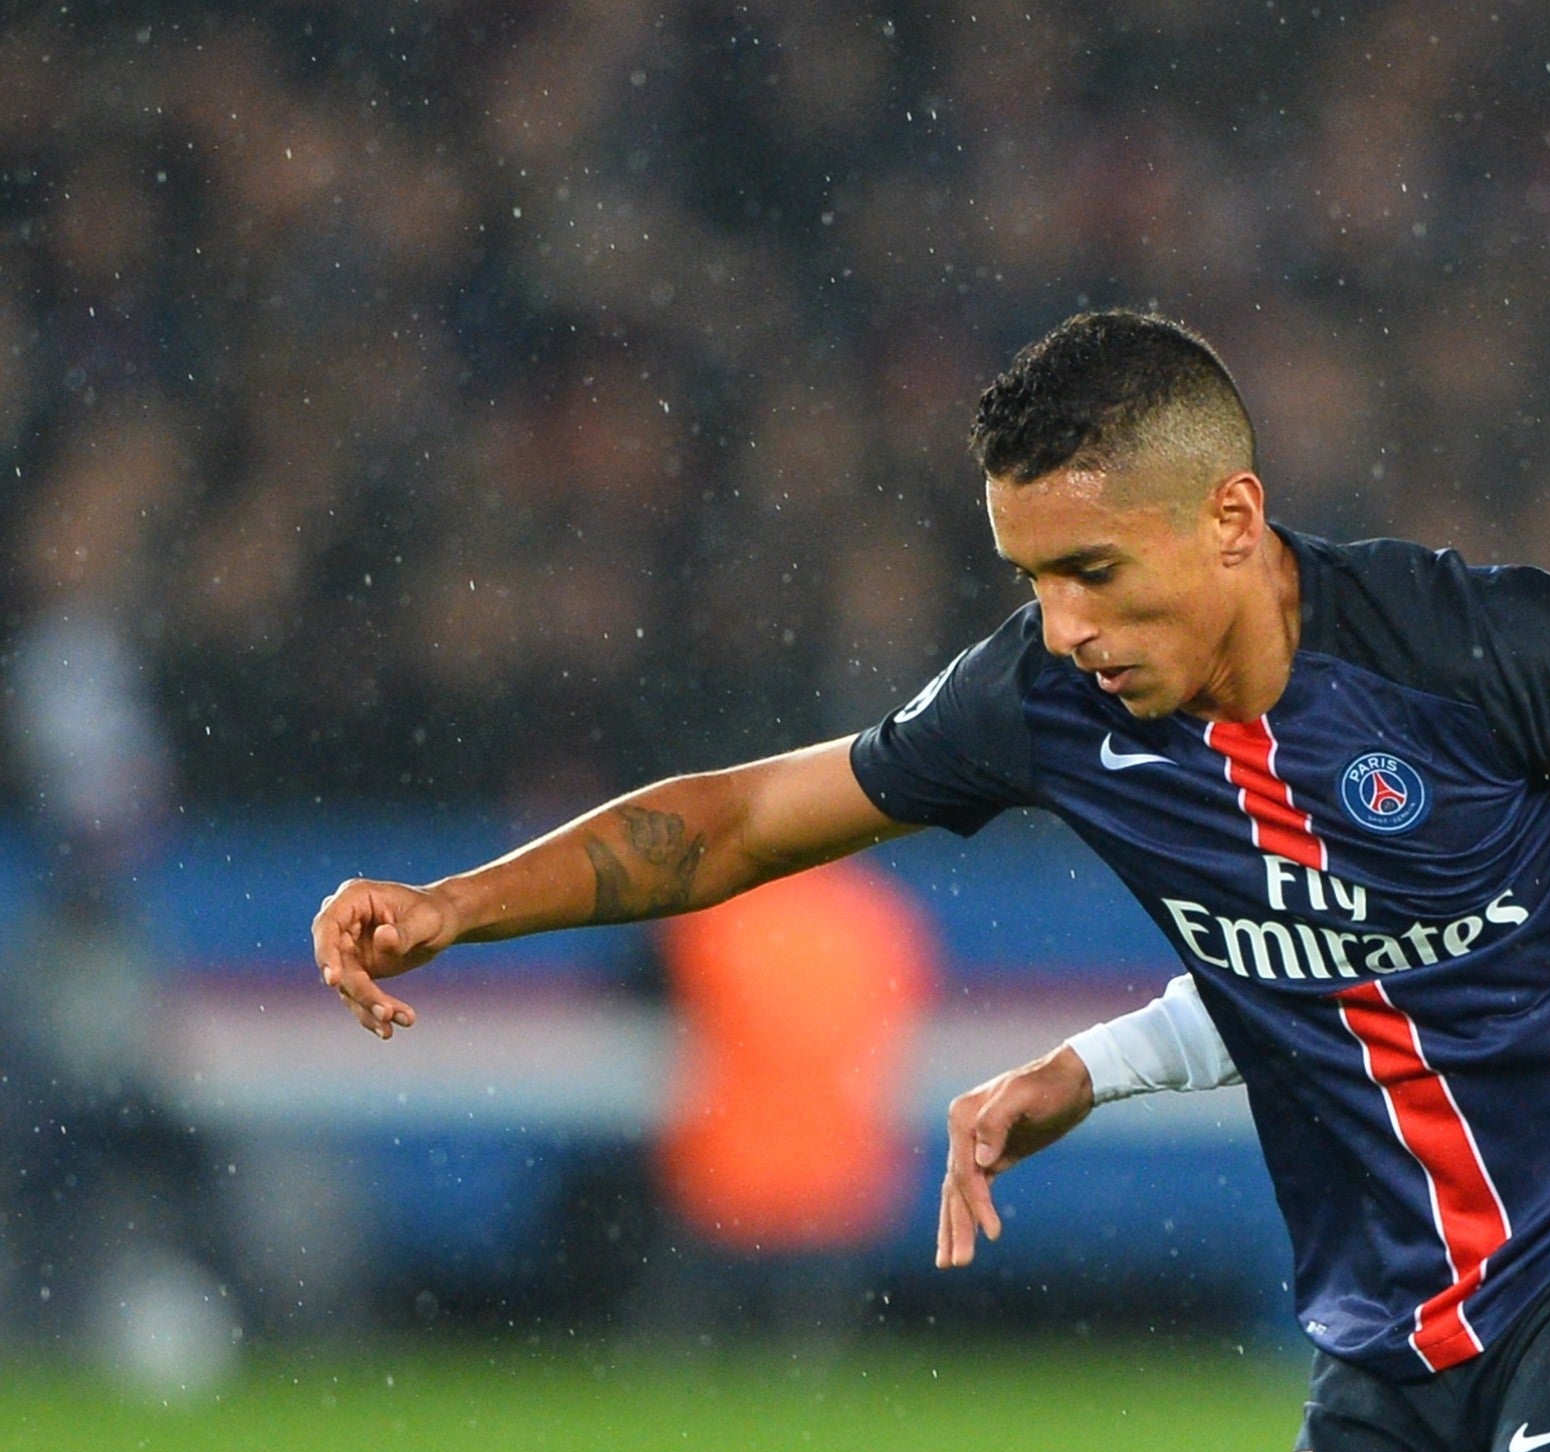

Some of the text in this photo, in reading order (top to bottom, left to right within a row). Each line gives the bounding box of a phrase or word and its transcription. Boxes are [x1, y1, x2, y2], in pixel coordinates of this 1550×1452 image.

[1349, 757, 1398, 783] PARIS
[1263, 854, 1367, 921] Fly
[1161, 888, 1530, 980] Emirates
